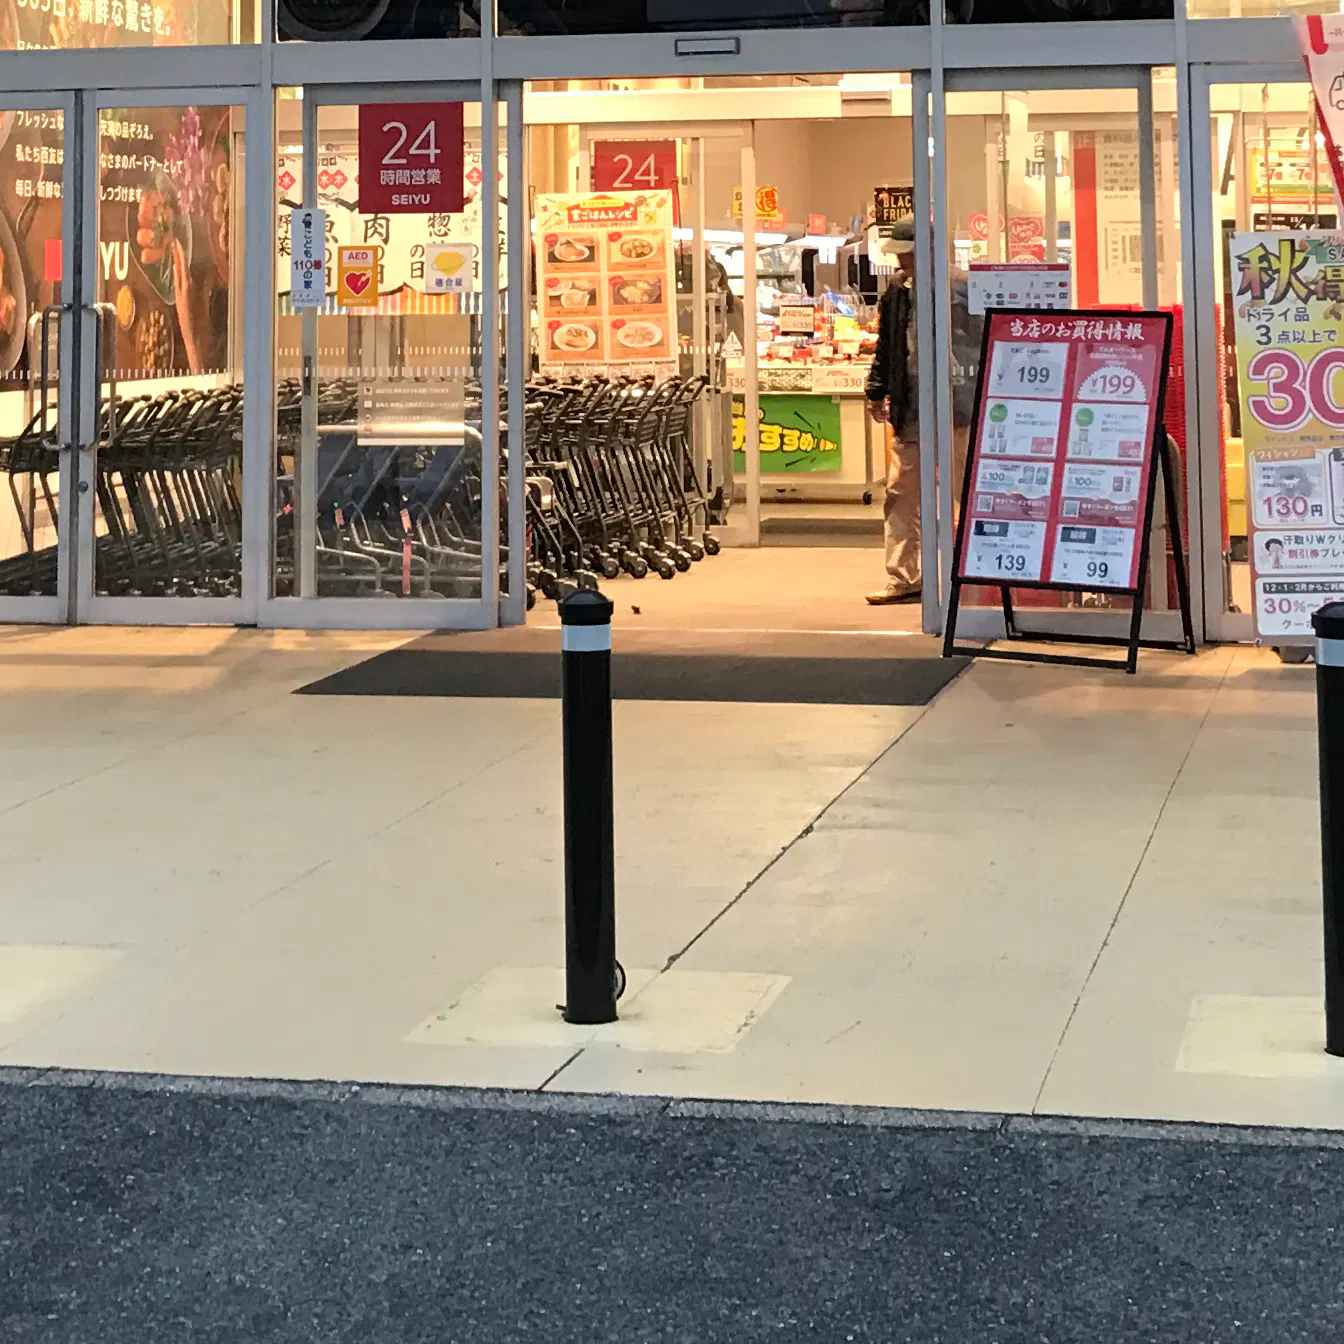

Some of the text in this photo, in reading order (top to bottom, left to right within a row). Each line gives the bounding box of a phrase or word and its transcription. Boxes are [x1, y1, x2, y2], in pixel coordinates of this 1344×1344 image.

[381, 120, 441, 165] 24
[380, 169, 441, 186] 時間営業
[612, 153, 659, 188] 24
[16, 179, 64, 199] 毎日、新鮮な
[392, 194, 430, 205] SEIYU
[882, 195, 913, 208] BLAC
[348, 251, 369, 261] AED
[1246, 307, 1310, 323] ドライ品
[1010, 319, 1145, 341] 当店のお買得情報
[1255, 324, 1337, 346] 3点以上で
[843, 377, 862, 387] 330
[1017, 366, 1050, 384] 199
[1263, 495, 1323, 518] 130円
[995, 553, 1026, 572] 139
[1086, 561, 1109, 579] 99
